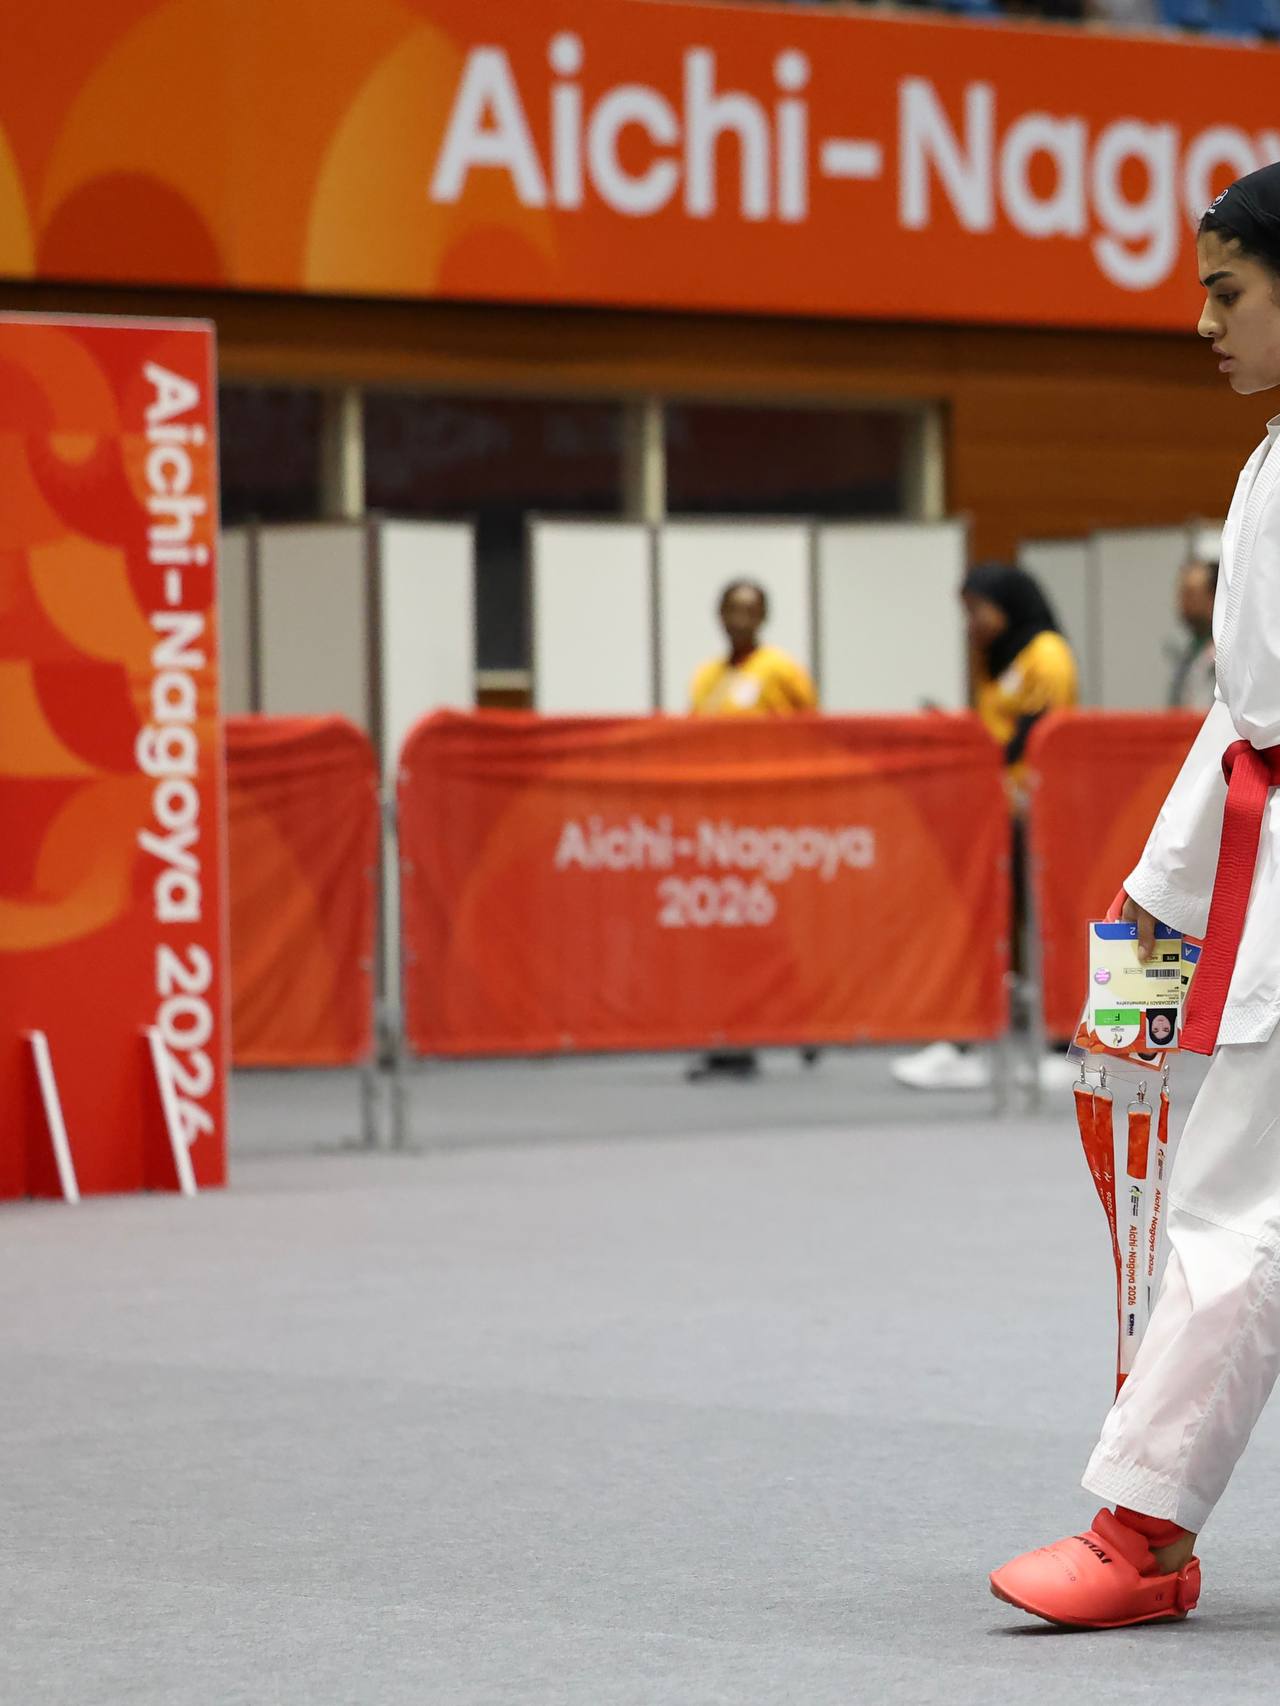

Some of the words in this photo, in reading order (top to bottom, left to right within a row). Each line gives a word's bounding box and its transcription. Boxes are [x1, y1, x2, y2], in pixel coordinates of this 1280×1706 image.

[135, 361, 208, 923] Aichi-Nagoya
[554, 814, 875, 882] Aichi-Nagoya
[657, 877, 778, 928] 2026
[1130, 927, 1136, 936] 2
[1185, 947, 1192, 956] A
[1115, 1013, 1120, 1021] F
[1147, 1188, 1162, 1252] Aichi-Nagoya
[1126, 1224, 1138, 1284] Aichi-Nagoya
[1127, 1285, 1137, 1307] 2026
